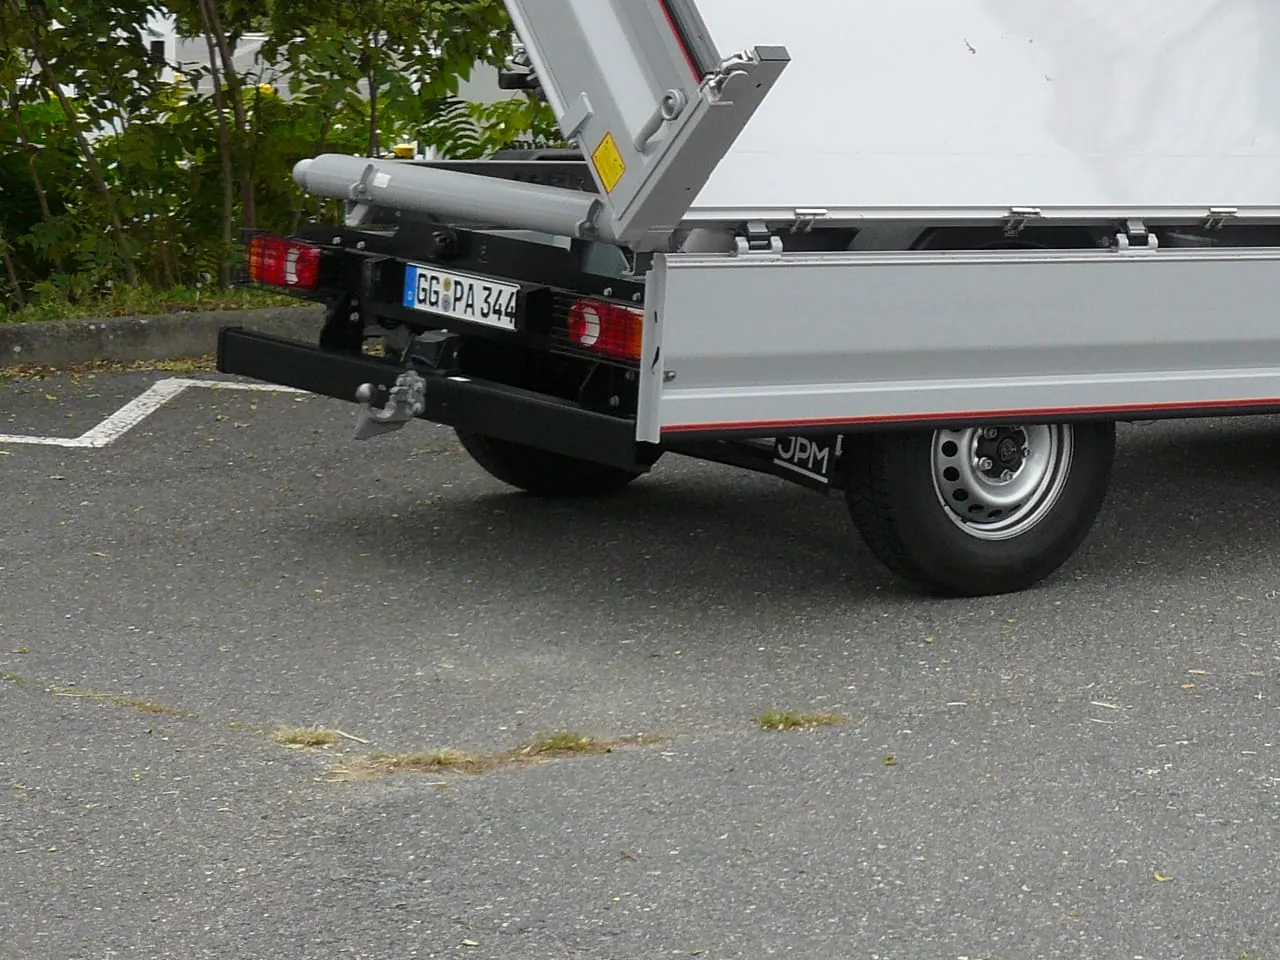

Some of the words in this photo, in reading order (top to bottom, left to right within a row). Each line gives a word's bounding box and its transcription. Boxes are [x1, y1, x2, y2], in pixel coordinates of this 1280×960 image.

[416, 272, 441, 309] GG
[452, 279, 476, 317] PA
[480, 285, 517, 325] 344
[777, 436, 830, 475] JPM
